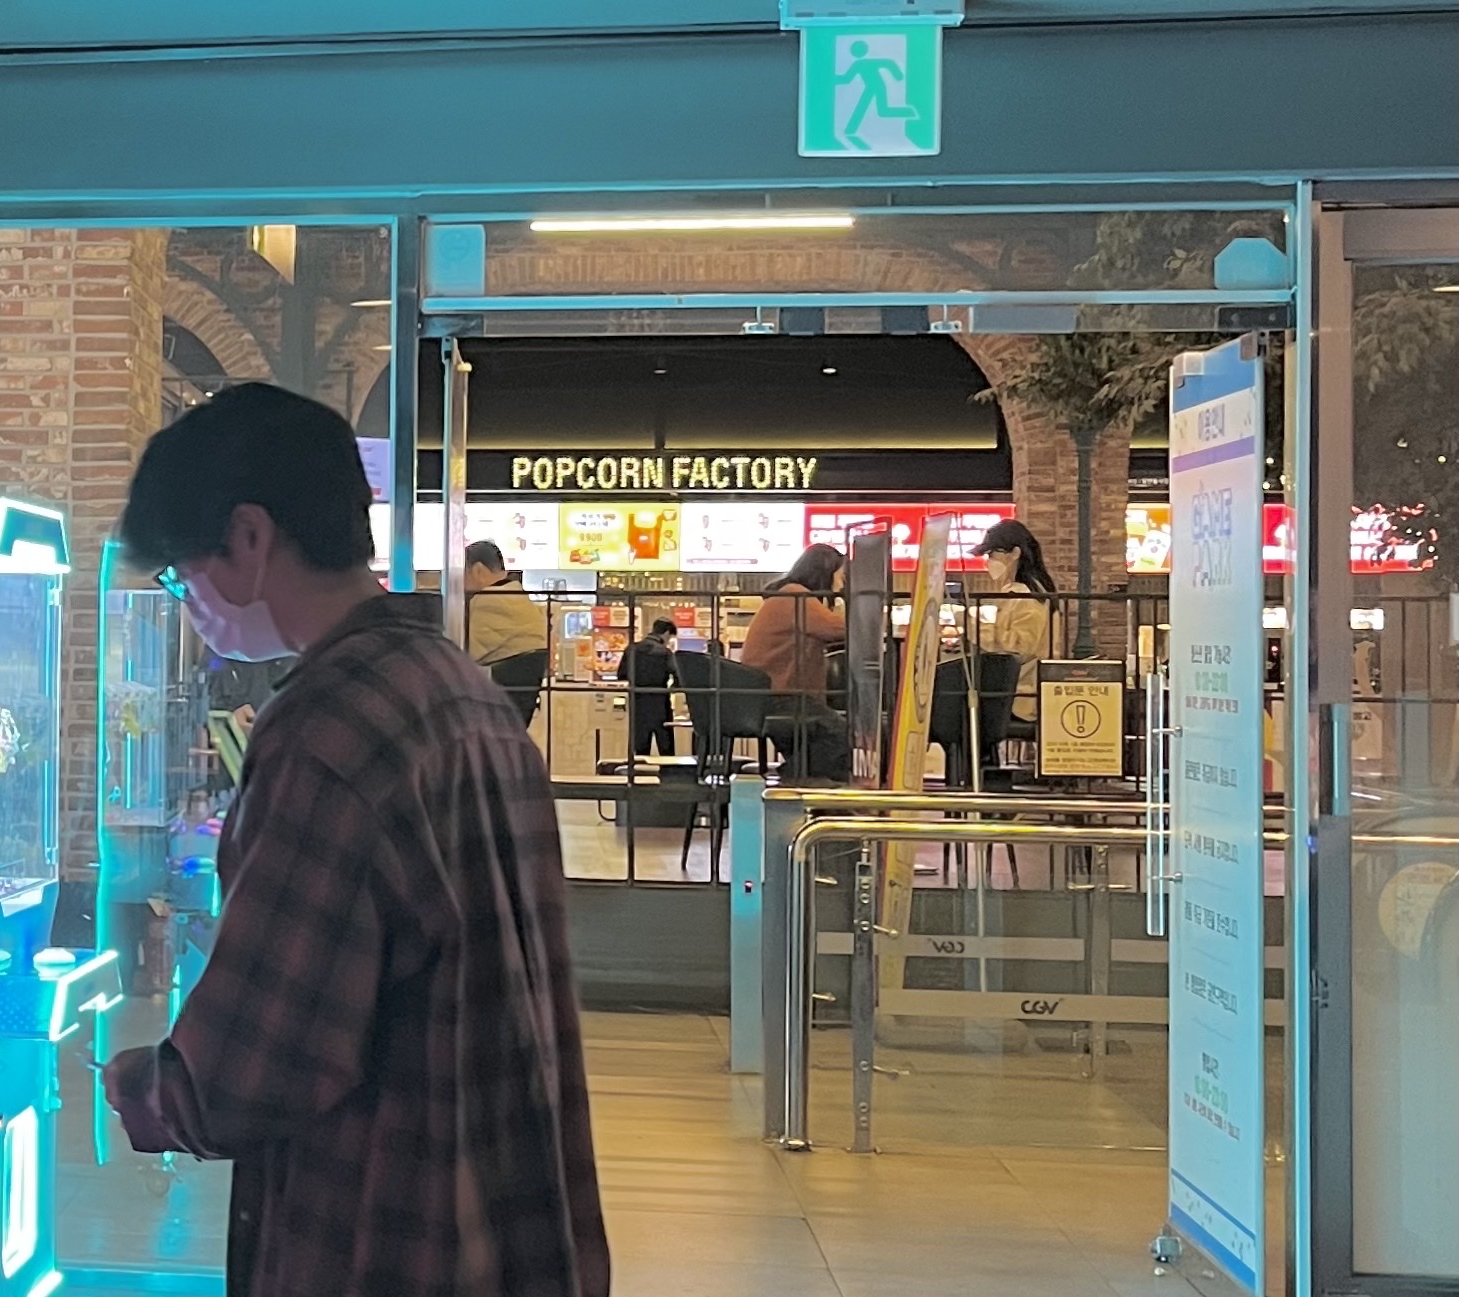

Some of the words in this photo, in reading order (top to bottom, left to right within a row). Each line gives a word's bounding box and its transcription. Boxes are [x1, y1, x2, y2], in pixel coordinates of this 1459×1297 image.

[511, 457, 663, 489] POPCORN
[672, 456, 817, 489] FACTORY
[1021, 999, 1060, 1014] CGV
